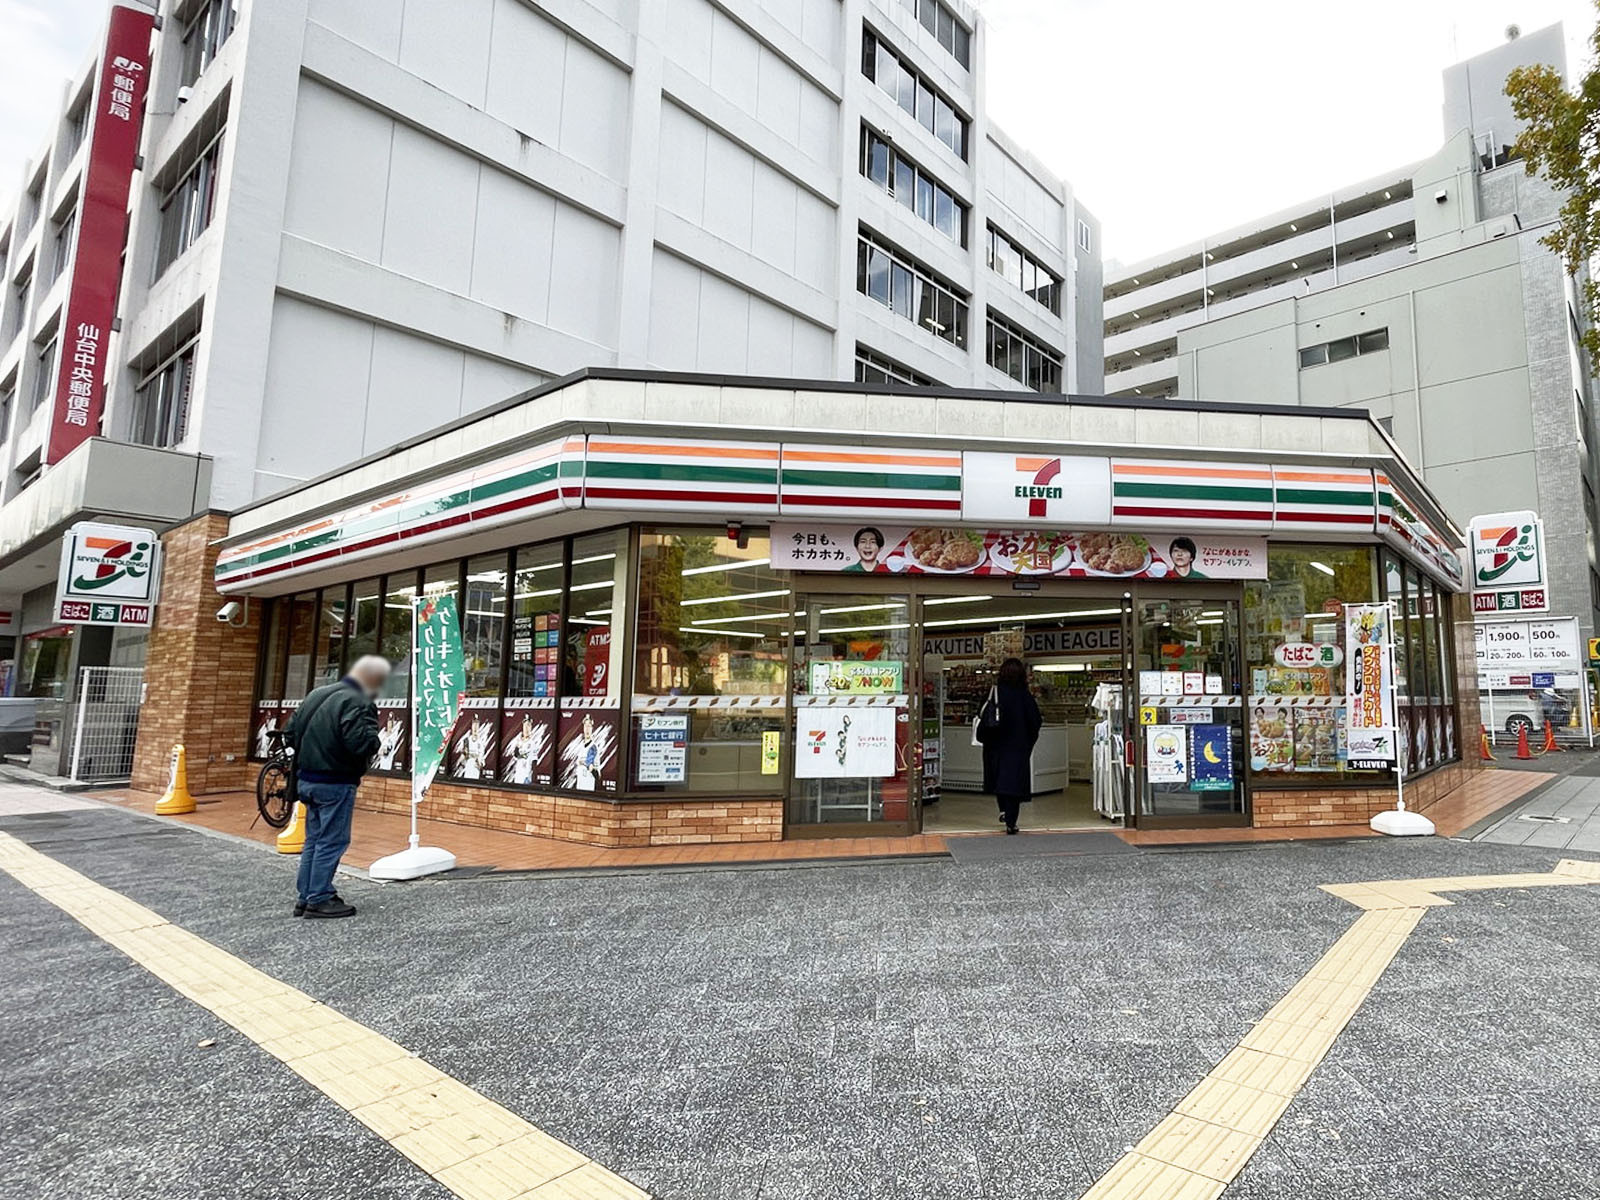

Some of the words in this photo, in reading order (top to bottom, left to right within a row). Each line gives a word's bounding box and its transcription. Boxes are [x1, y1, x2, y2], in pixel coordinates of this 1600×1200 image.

[108, 74, 136, 121] 郵便局
[65, 322, 100, 427] 仙台中央郵便局
[791, 532, 836, 546] 今日も、
[791, 549, 851, 561] ホカホカ。
[1010, 551, 1053, 575] 天国
[1475, 595, 1496, 610] ATM
[1501, 594, 1517, 608] 酒
[1521, 592, 1544, 607] たばこ
[61, 604, 89, 619] たばこ
[97, 606, 115, 620] 酒
[122, 607, 148, 622] ATM
[1283, 646, 1314, 661] たばこ
[1320, 646, 1334, 661] 酒
[1363, 645, 1375, 728] ダウンロードカード
